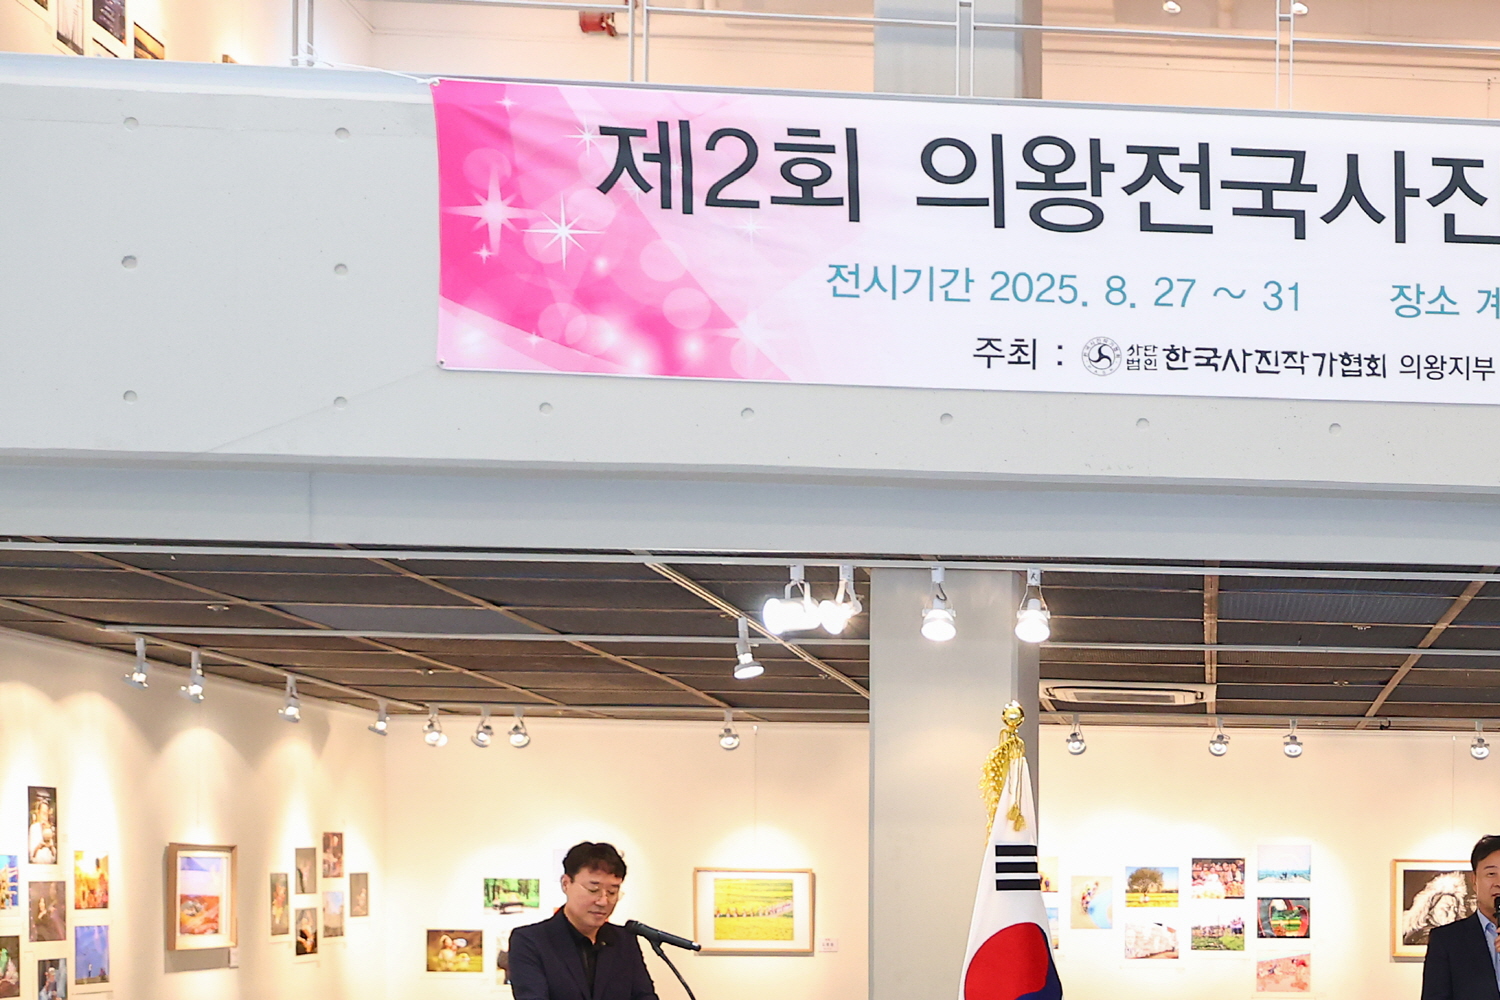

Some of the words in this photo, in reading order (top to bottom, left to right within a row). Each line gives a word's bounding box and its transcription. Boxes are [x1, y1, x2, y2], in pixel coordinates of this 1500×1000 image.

[596, 119, 861, 222] 제2회
[826, 262, 974, 304] 전시기간
[989, 269, 1088, 307] 2025.
[1104, 275, 1136, 308] 8.
[1153, 275, 1196, 309] 27
[1262, 281, 1300, 312] 31
[1389, 282, 1460, 319] 장소
[972, 337, 1037, 371] 주최
[1162, 344, 1388, 379] 한국사진작가협회
[1399, 353, 1496, 382] 의왕지부
